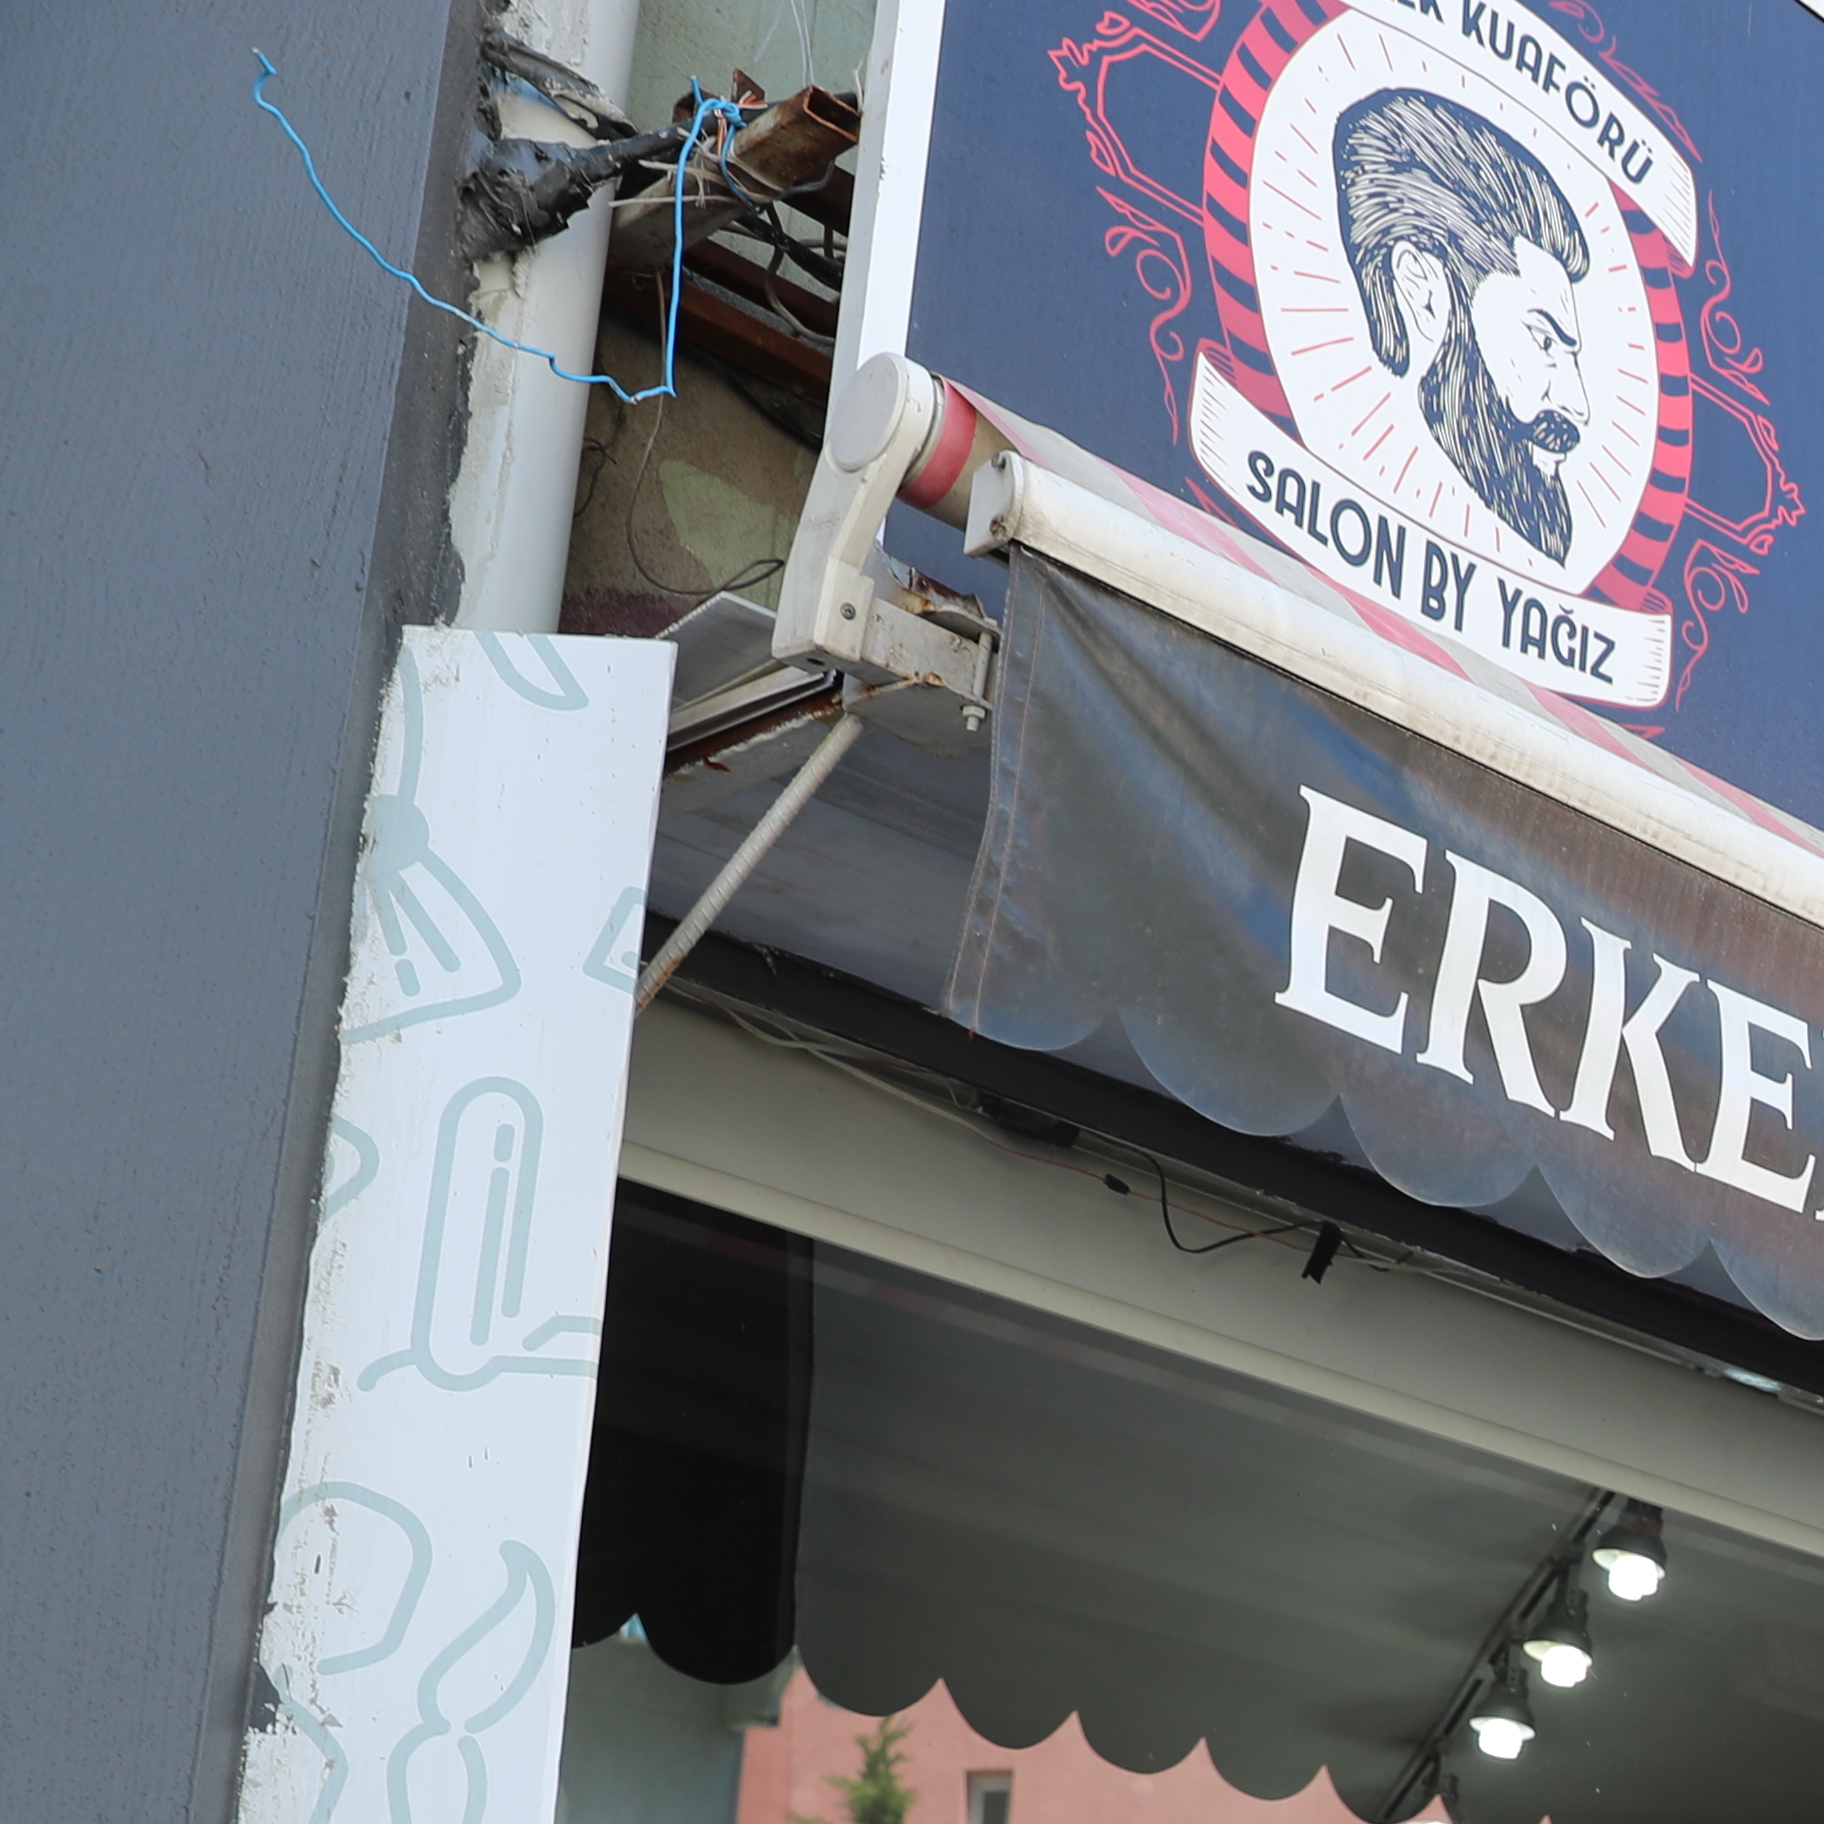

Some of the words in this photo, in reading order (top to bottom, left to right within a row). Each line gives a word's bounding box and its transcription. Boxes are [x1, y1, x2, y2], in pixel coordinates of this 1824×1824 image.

[1462, 1, 1654, 185] KUAFÖRÜ
[1245, 451, 1404, 599] SALON
[1421, 522, 1475, 632] BY
[1497, 577, 1617, 685] YAĞIZ
